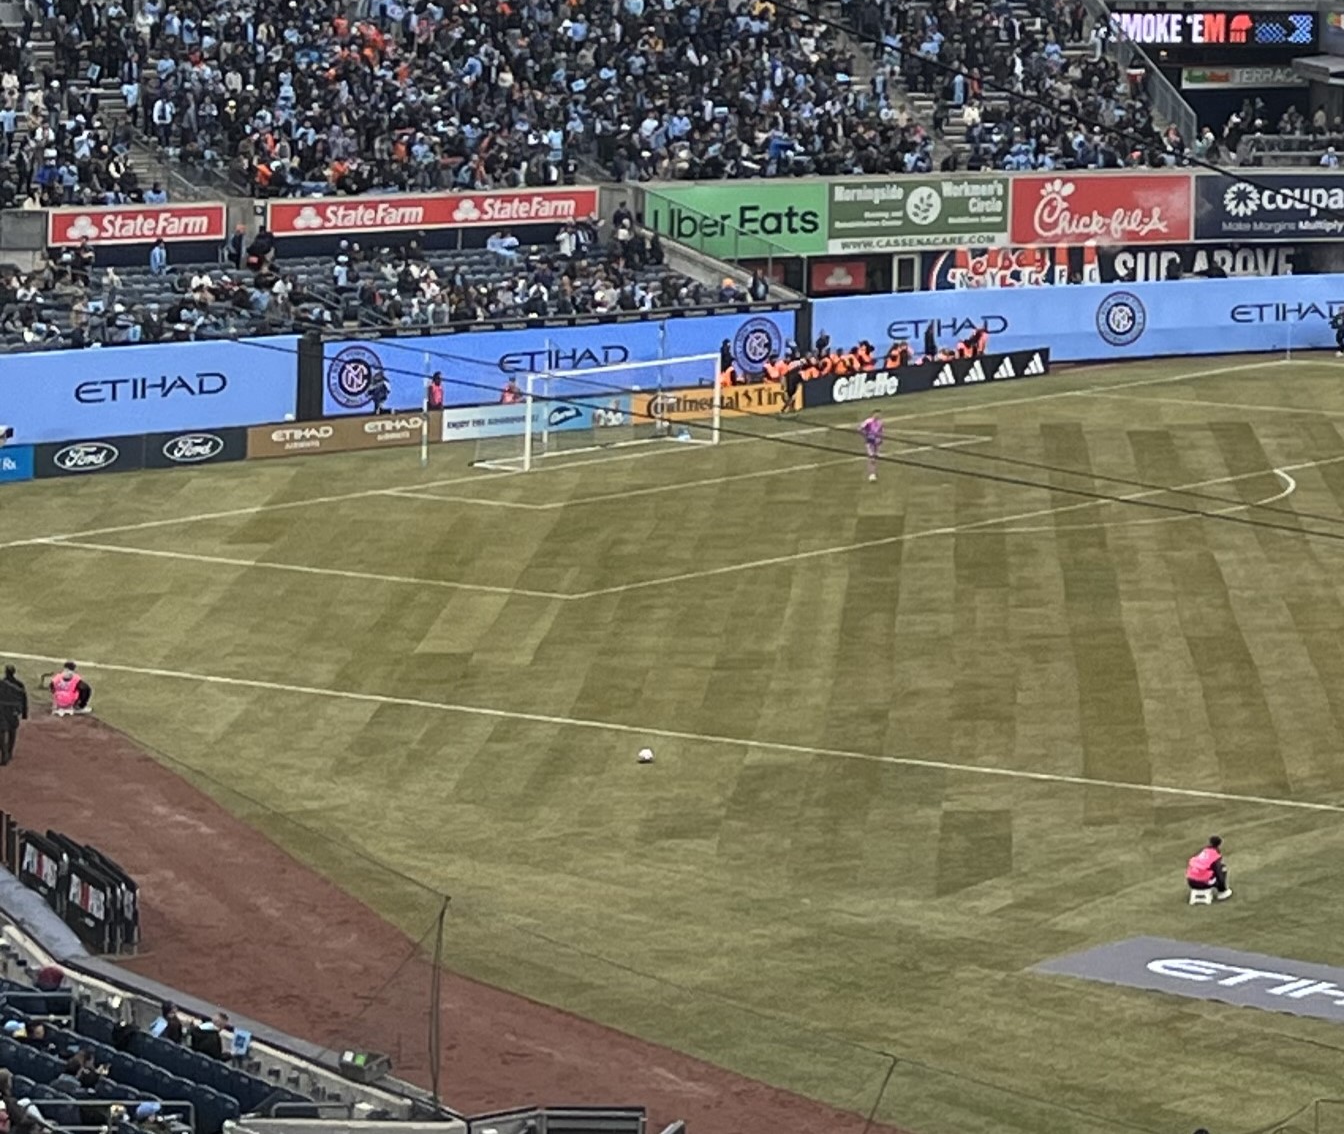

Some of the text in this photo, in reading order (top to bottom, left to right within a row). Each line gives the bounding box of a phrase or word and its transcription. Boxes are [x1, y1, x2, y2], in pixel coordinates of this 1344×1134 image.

[1108, 12, 1184, 44] SMOKE
[101, 212, 209, 239] StateFarm
[324, 196, 575, 228] StateFarm StateFarm
[738, 204, 820, 236] Eats
[1033, 189, 1169, 238] Chick-fil-A
[499, 344, 629, 375] ETIHAD
[74, 371, 228, 405] ETIHAD
[832, 370, 898, 404] Gillette
[271, 425, 334, 443] ETIHAD
[363, 417, 422, 434] ETIHAD
[64, 446, 107, 468] Ford
[173, 437, 214, 458] Ford
